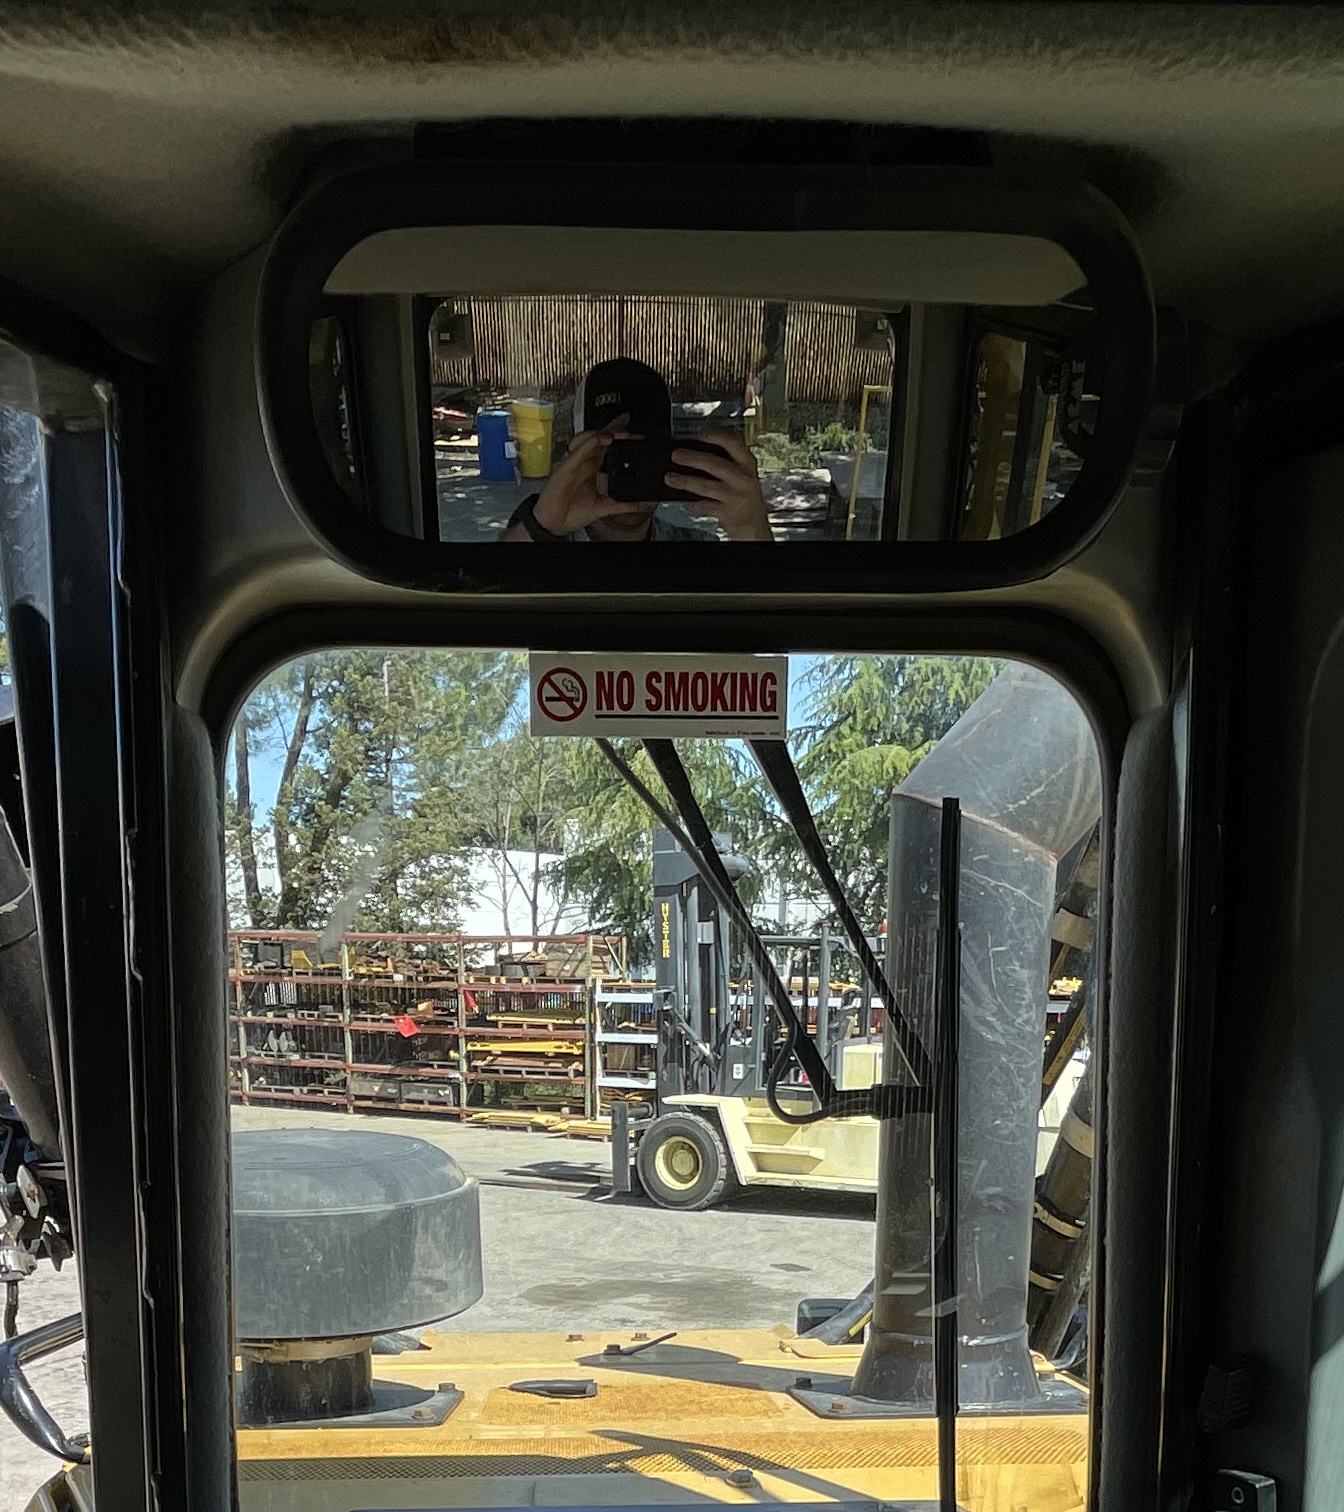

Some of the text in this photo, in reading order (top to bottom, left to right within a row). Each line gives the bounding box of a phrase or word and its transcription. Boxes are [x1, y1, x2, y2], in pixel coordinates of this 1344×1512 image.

[595, 670, 778, 713] NO SMOKING
[661, 902, 671, 958] HYSTER
